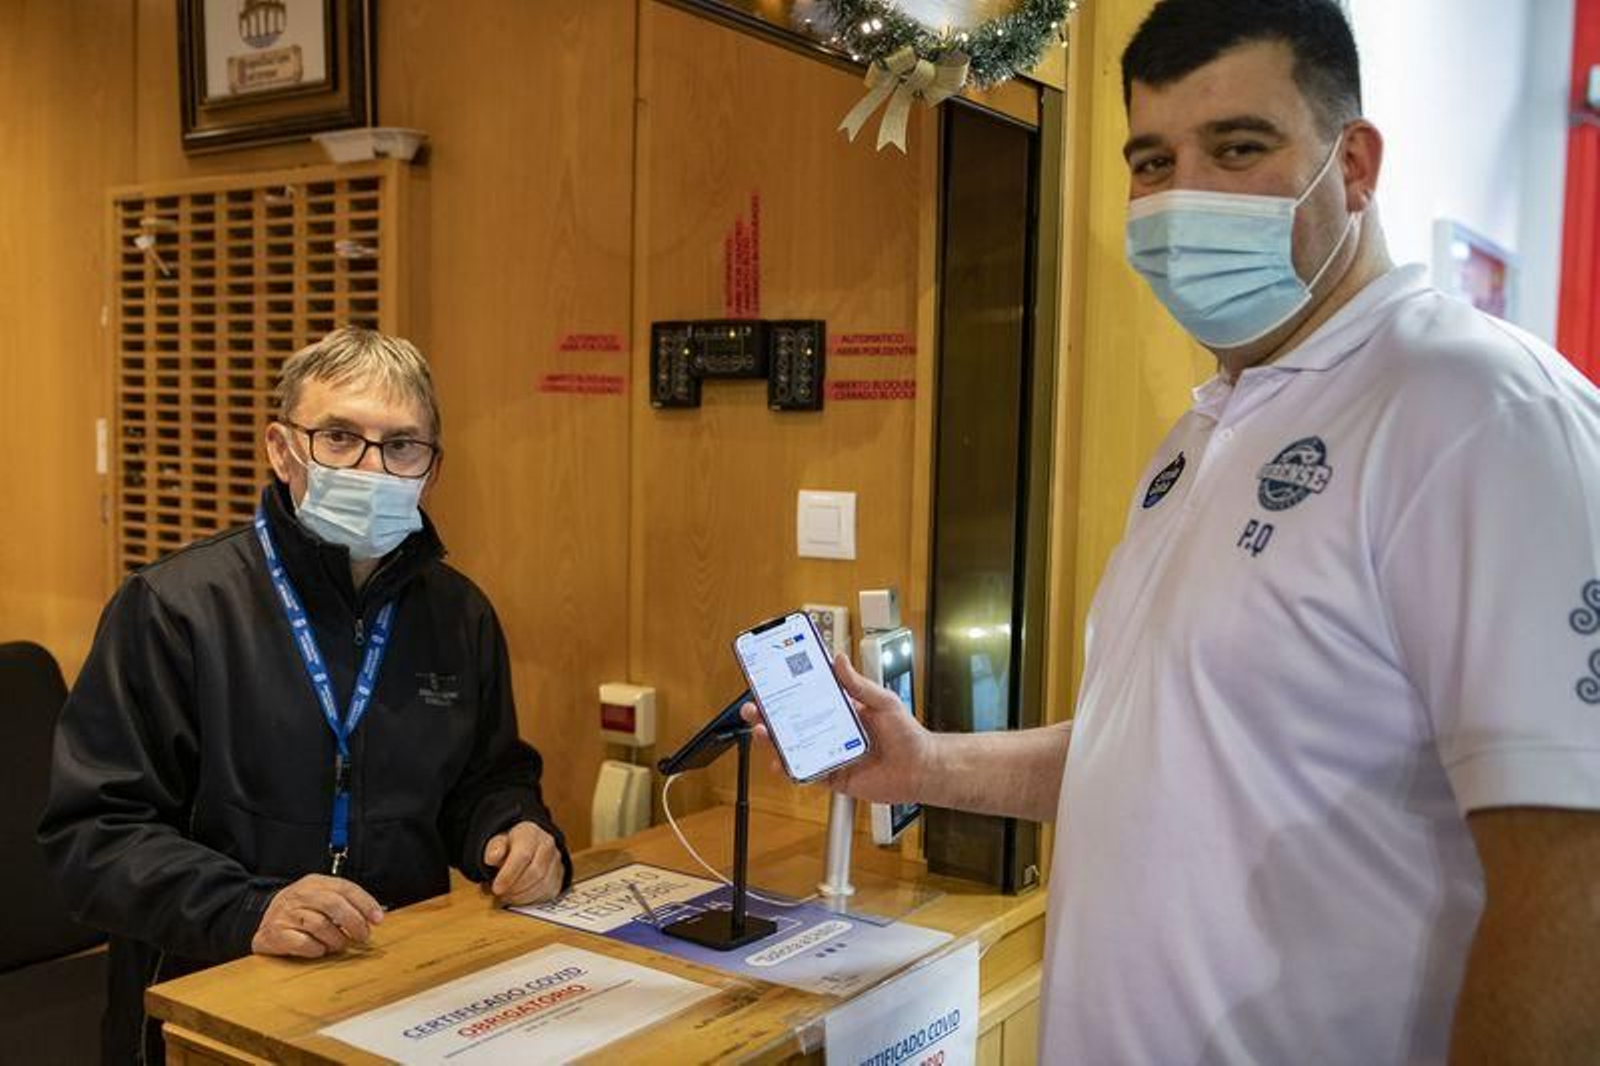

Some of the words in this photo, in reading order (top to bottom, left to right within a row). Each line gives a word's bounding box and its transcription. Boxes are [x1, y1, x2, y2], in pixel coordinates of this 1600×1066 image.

[402, 987, 527, 1039] CERTIFICADO
[525, 966, 584, 994] COVID
[457, 984, 588, 1038] OBRIGATORIO
[926, 1008, 961, 1041] COVID
